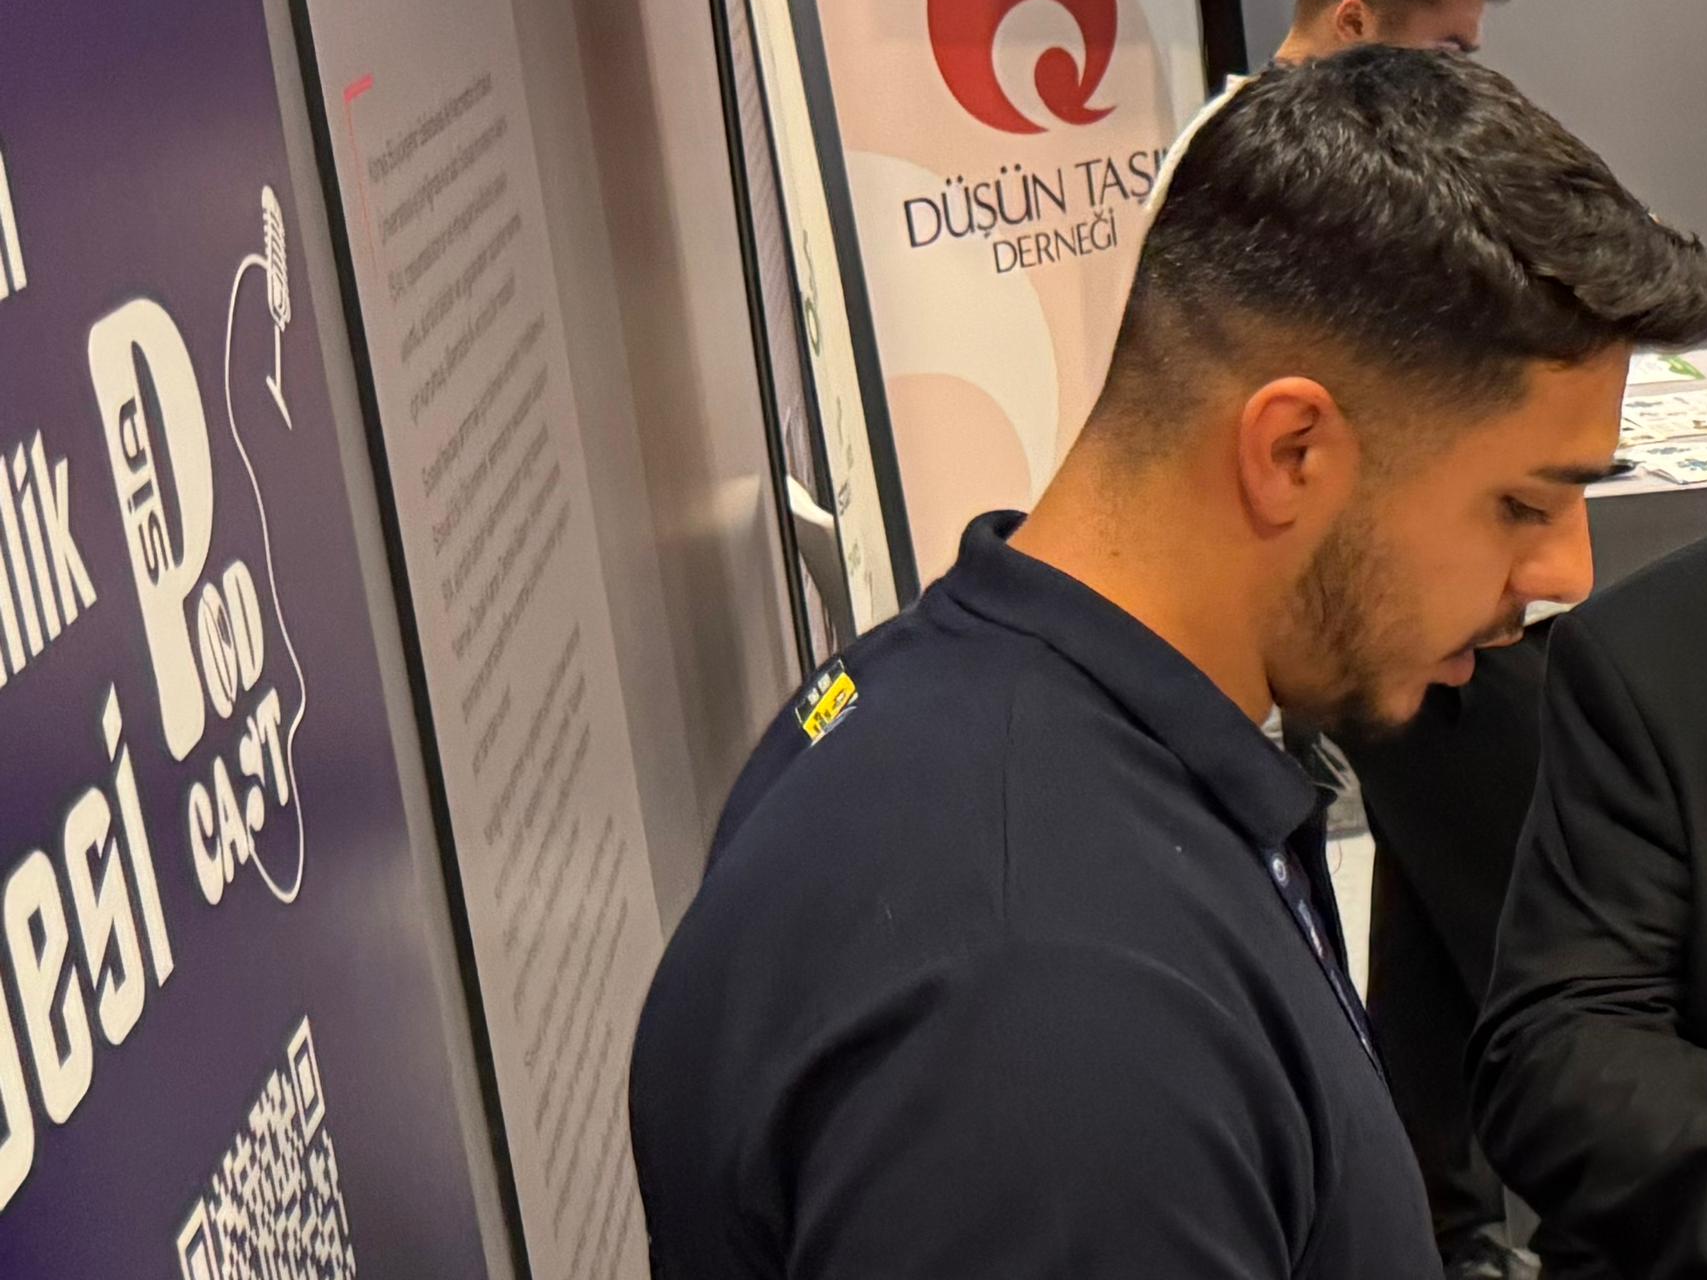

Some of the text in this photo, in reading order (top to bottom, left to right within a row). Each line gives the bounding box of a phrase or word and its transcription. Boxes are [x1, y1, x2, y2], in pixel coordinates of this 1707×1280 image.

[903, 148, 1172, 249] DÜŞÜN TAŞI
[994, 206, 1119, 274] DERNEĞİ
